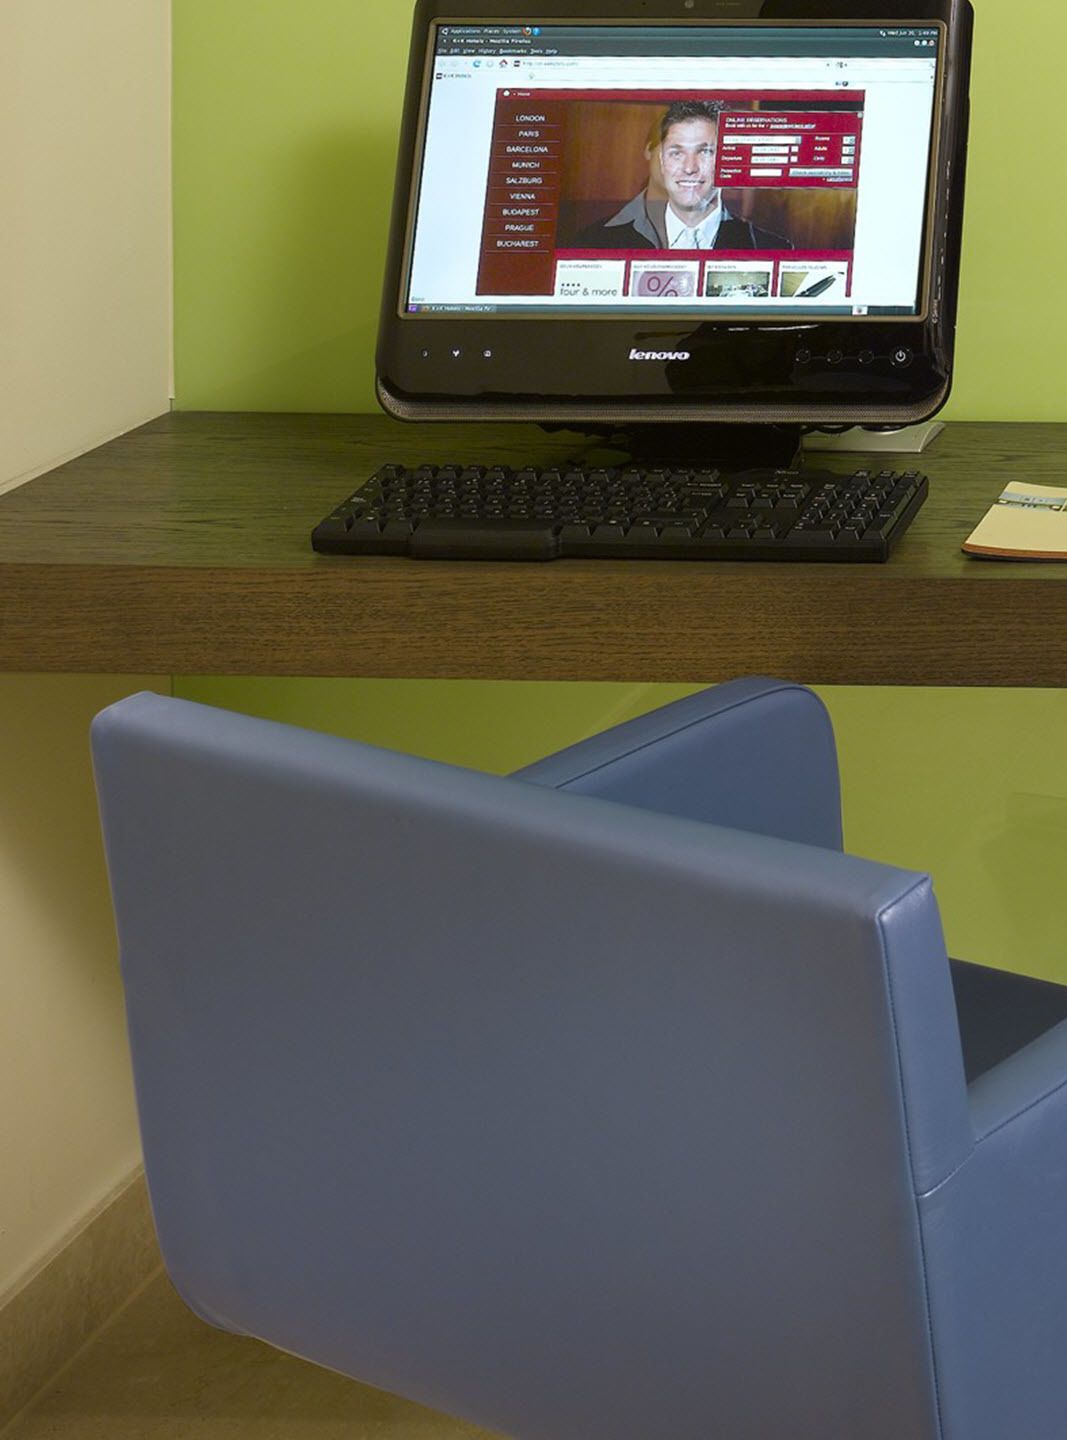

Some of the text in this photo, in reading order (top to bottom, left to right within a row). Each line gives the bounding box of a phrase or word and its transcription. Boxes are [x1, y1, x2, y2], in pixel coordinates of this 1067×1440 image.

[515, 114, 545, 122] LONDON
[506, 145, 548, 153] BARCELONA
[502, 208, 540, 216] BUDAPEST
[582, 288, 590, 296] &
[592, 289, 618, 297] more
[628, 348, 691, 360] lenovo
